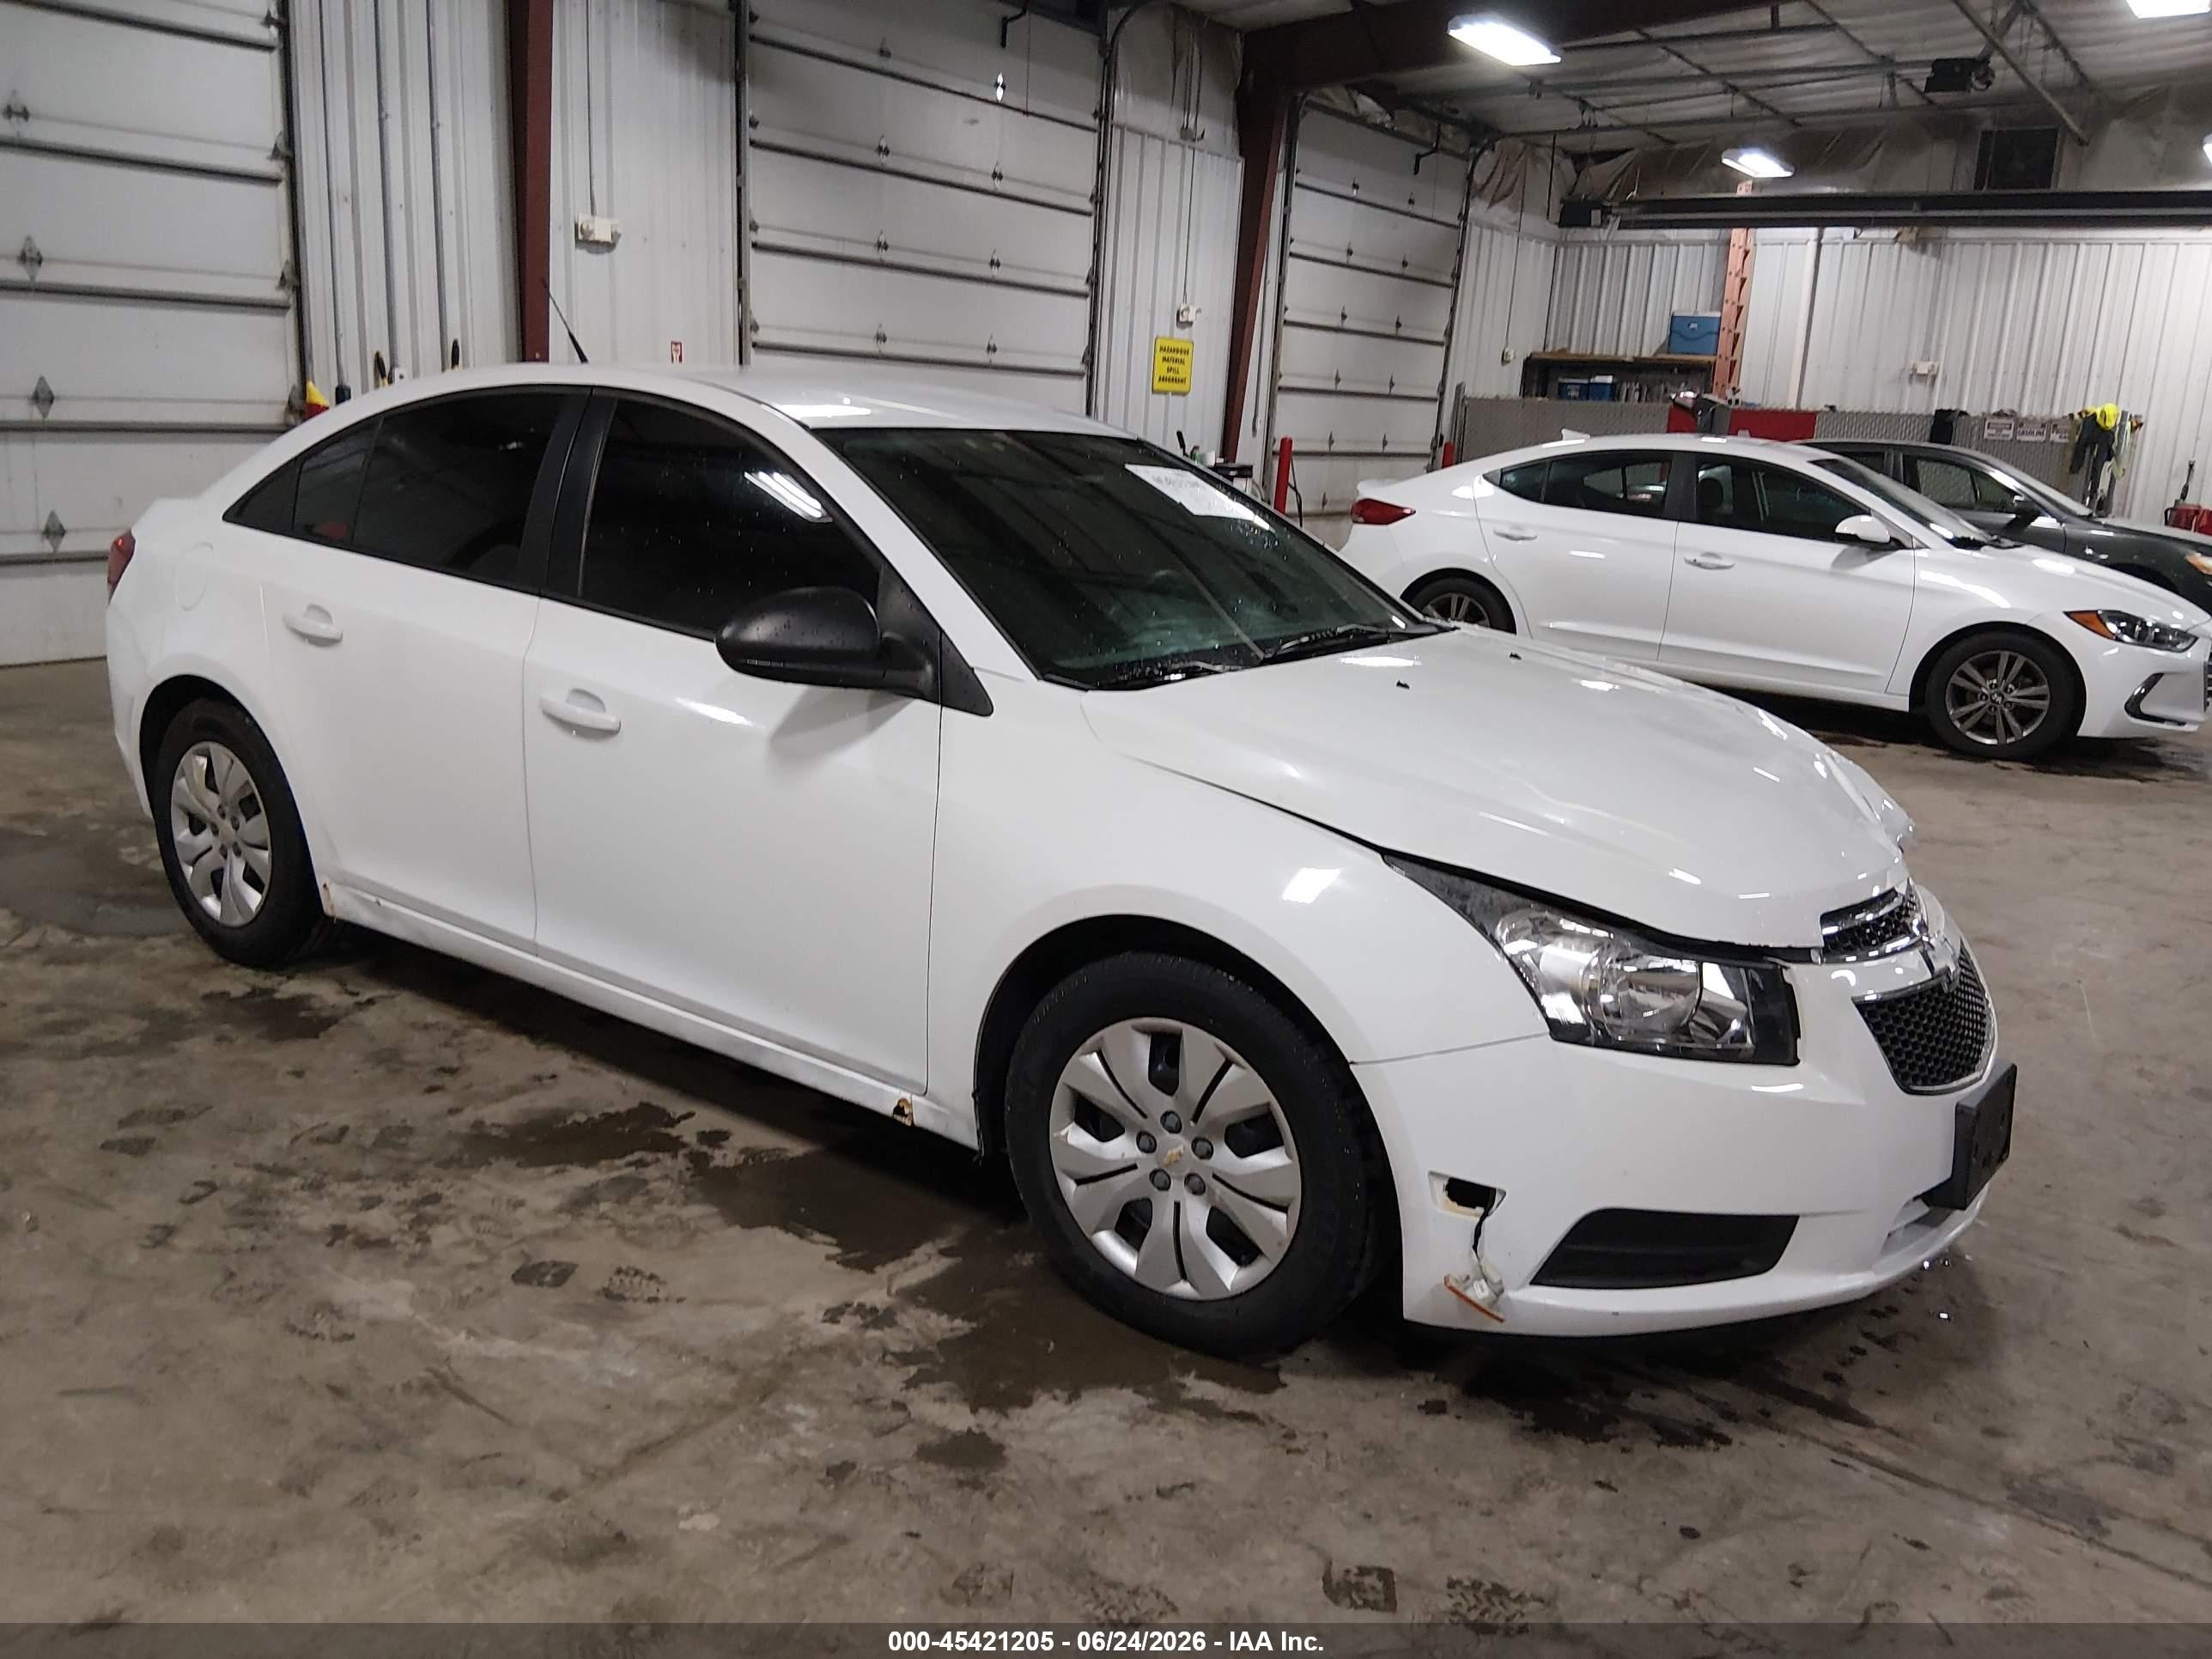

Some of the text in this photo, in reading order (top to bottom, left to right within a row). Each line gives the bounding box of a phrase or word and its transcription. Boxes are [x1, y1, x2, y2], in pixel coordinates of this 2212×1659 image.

[1159, 344, 1189, 356] HAZARDOUS
[1162, 356, 1185, 365] MATERIAL
[1166, 366, 1180, 374] SPILL
[1158, 375, 1187, 385] ABSORBENT
